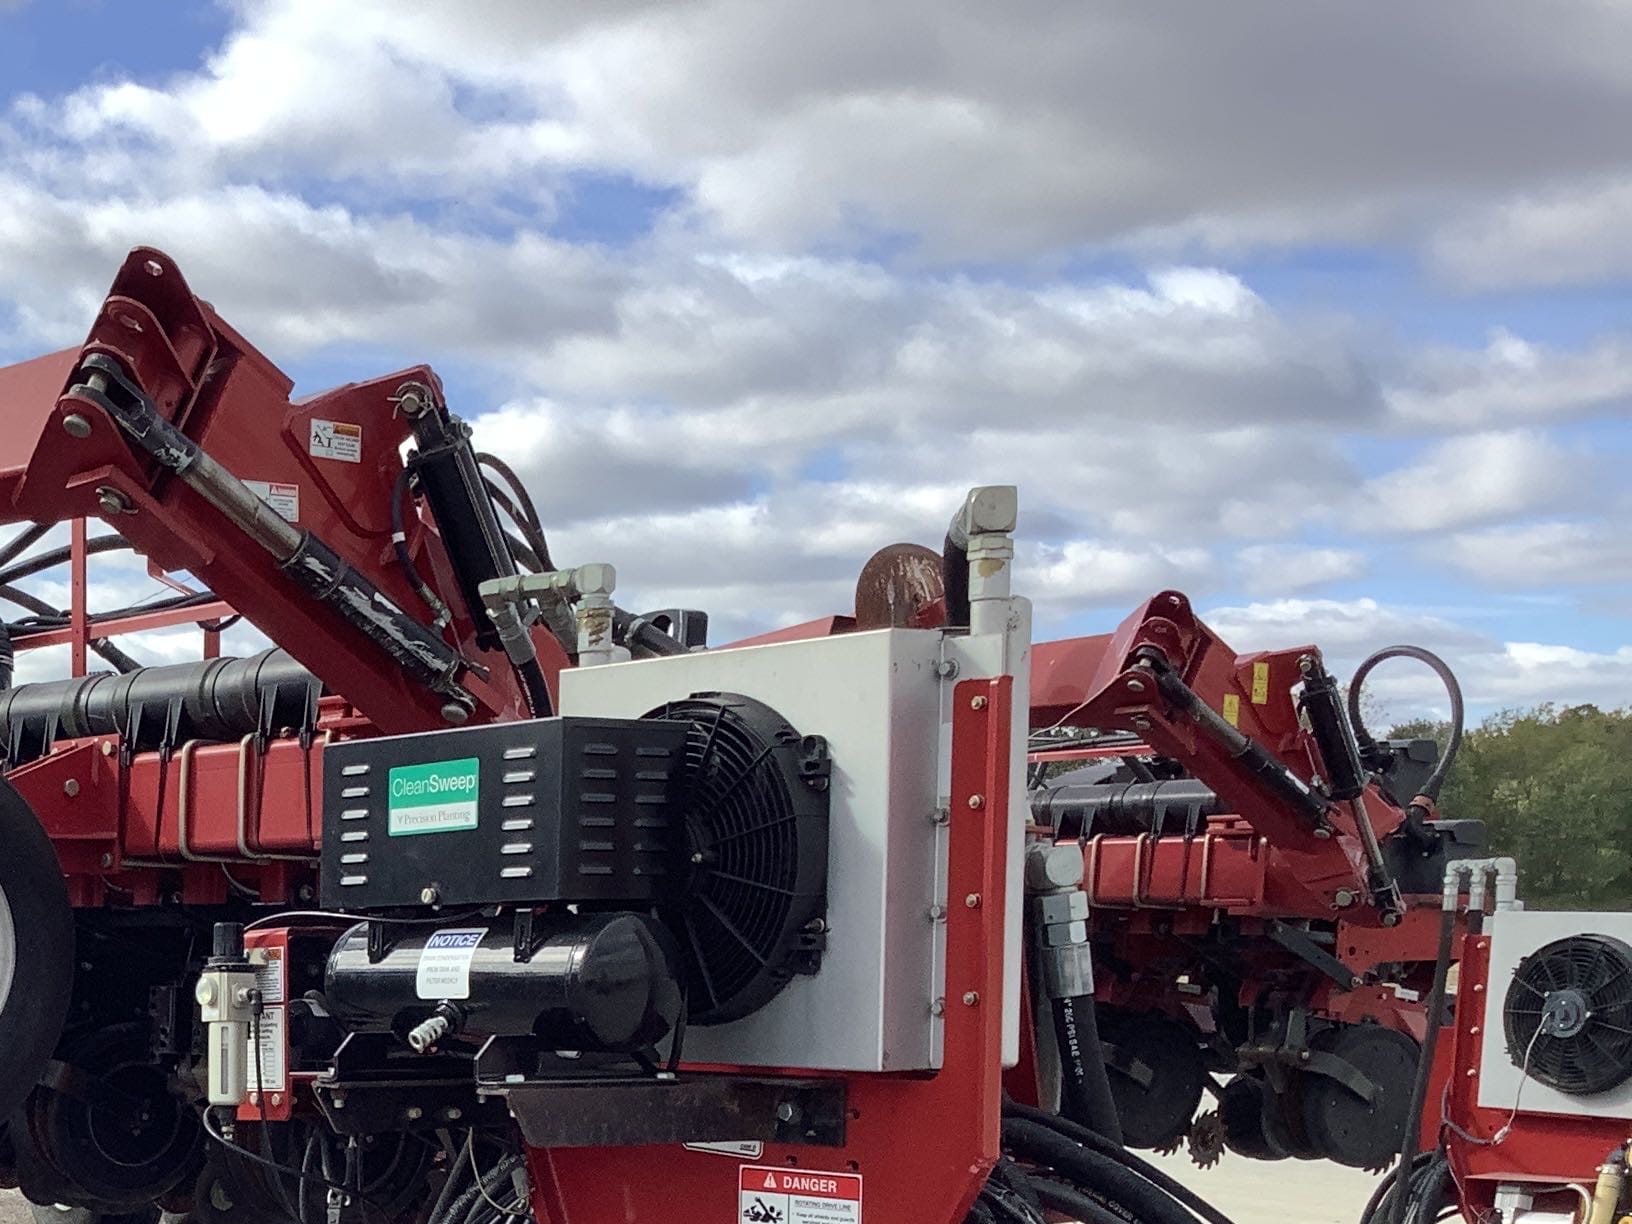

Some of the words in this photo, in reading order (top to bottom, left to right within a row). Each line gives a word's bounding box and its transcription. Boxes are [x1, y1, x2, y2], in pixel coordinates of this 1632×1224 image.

[392, 774, 476, 797] CleanSweep
[404, 814, 437, 825] Precision
[438, 810, 471, 823] Planting
[430, 934, 479, 947] NOTICE
[783, 1176, 837, 1193] DANGER
